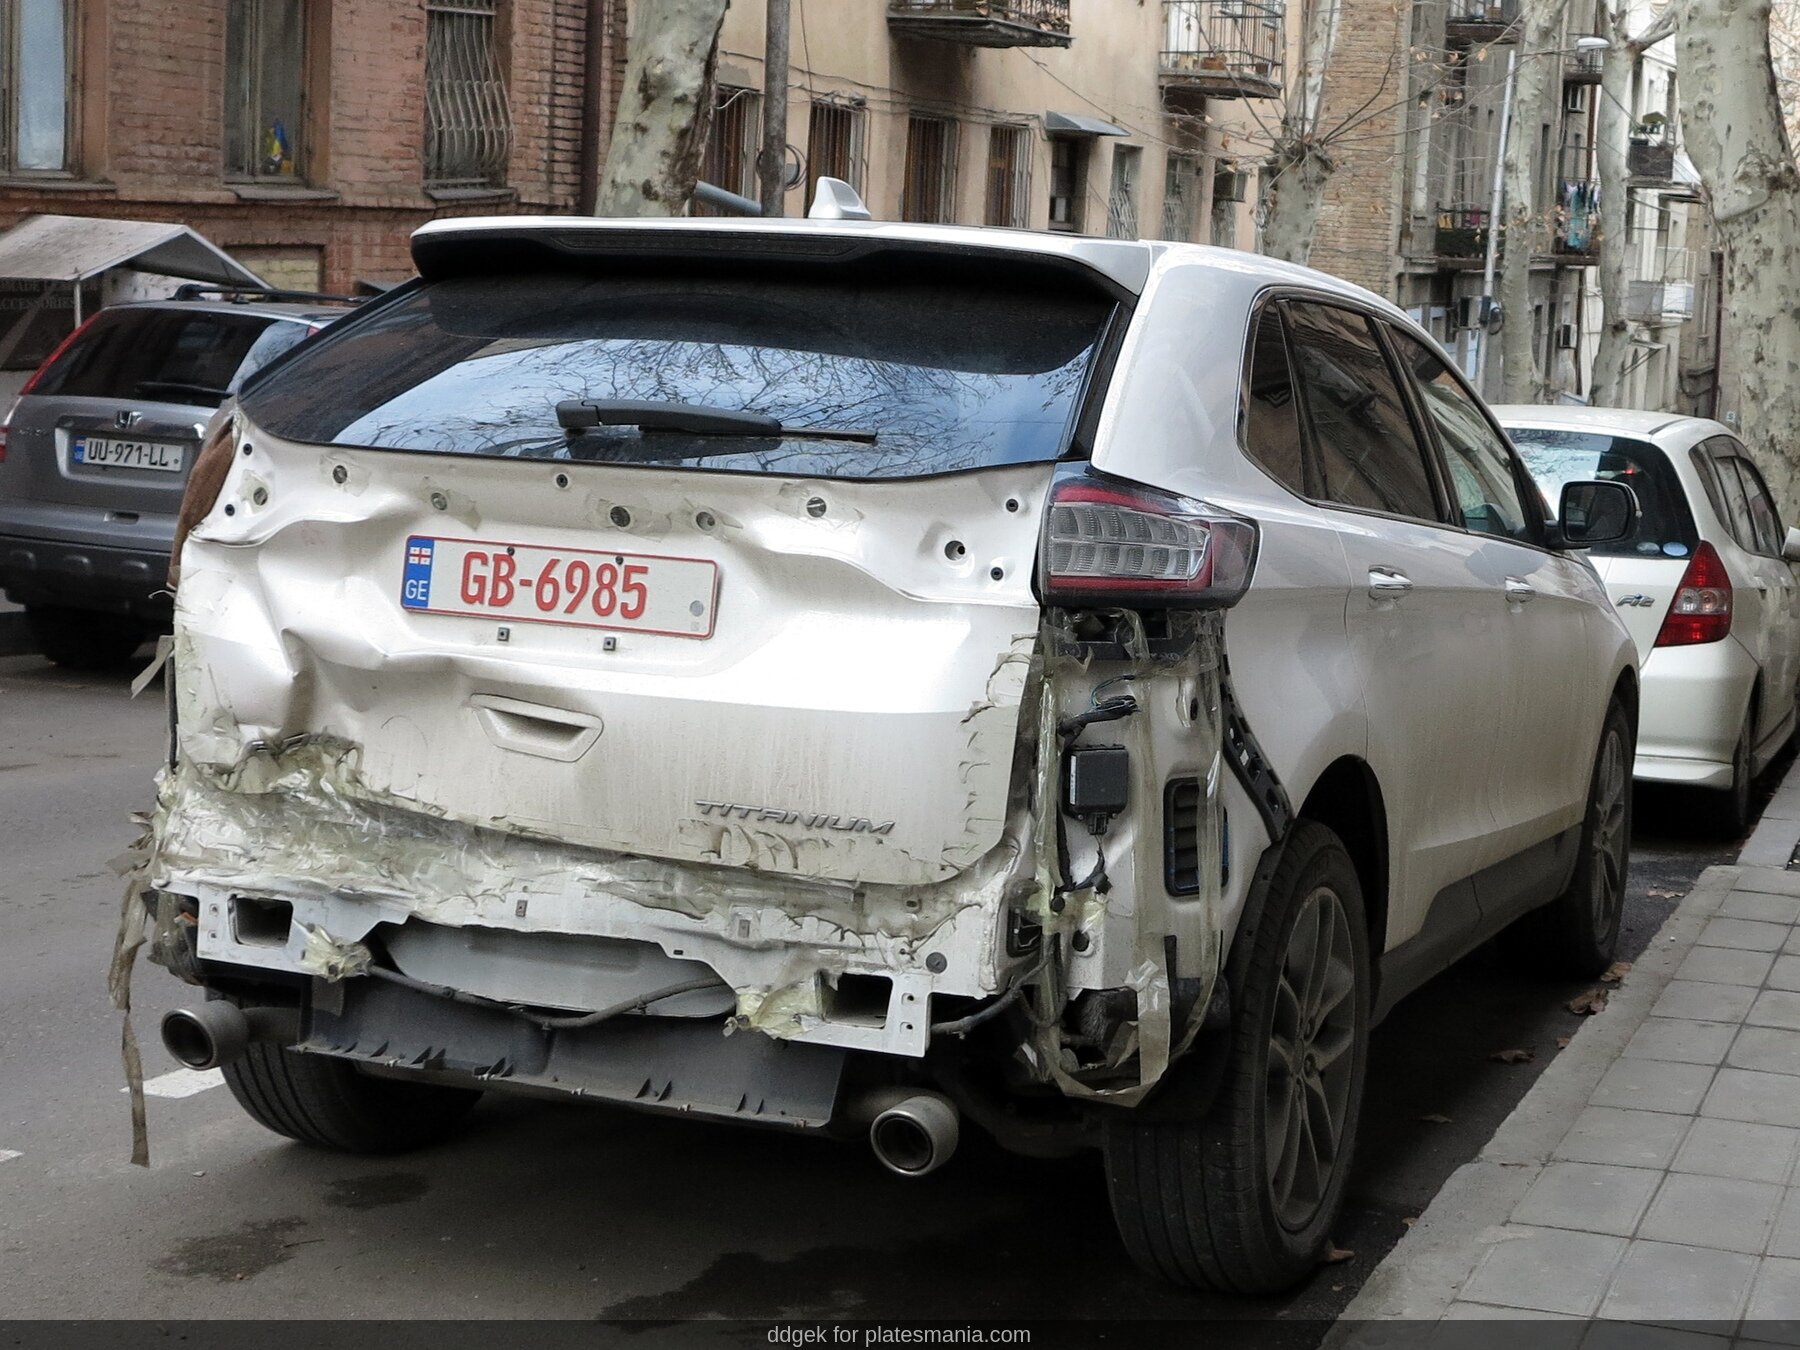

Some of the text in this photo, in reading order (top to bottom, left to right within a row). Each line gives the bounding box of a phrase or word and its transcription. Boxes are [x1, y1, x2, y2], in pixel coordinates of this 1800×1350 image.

[88, 438, 168, 467] UU-971-LL
[405, 578, 428, 601] GE
[459, 550, 650, 620] GB-6985
[696, 800, 896, 835] TITANIUM
